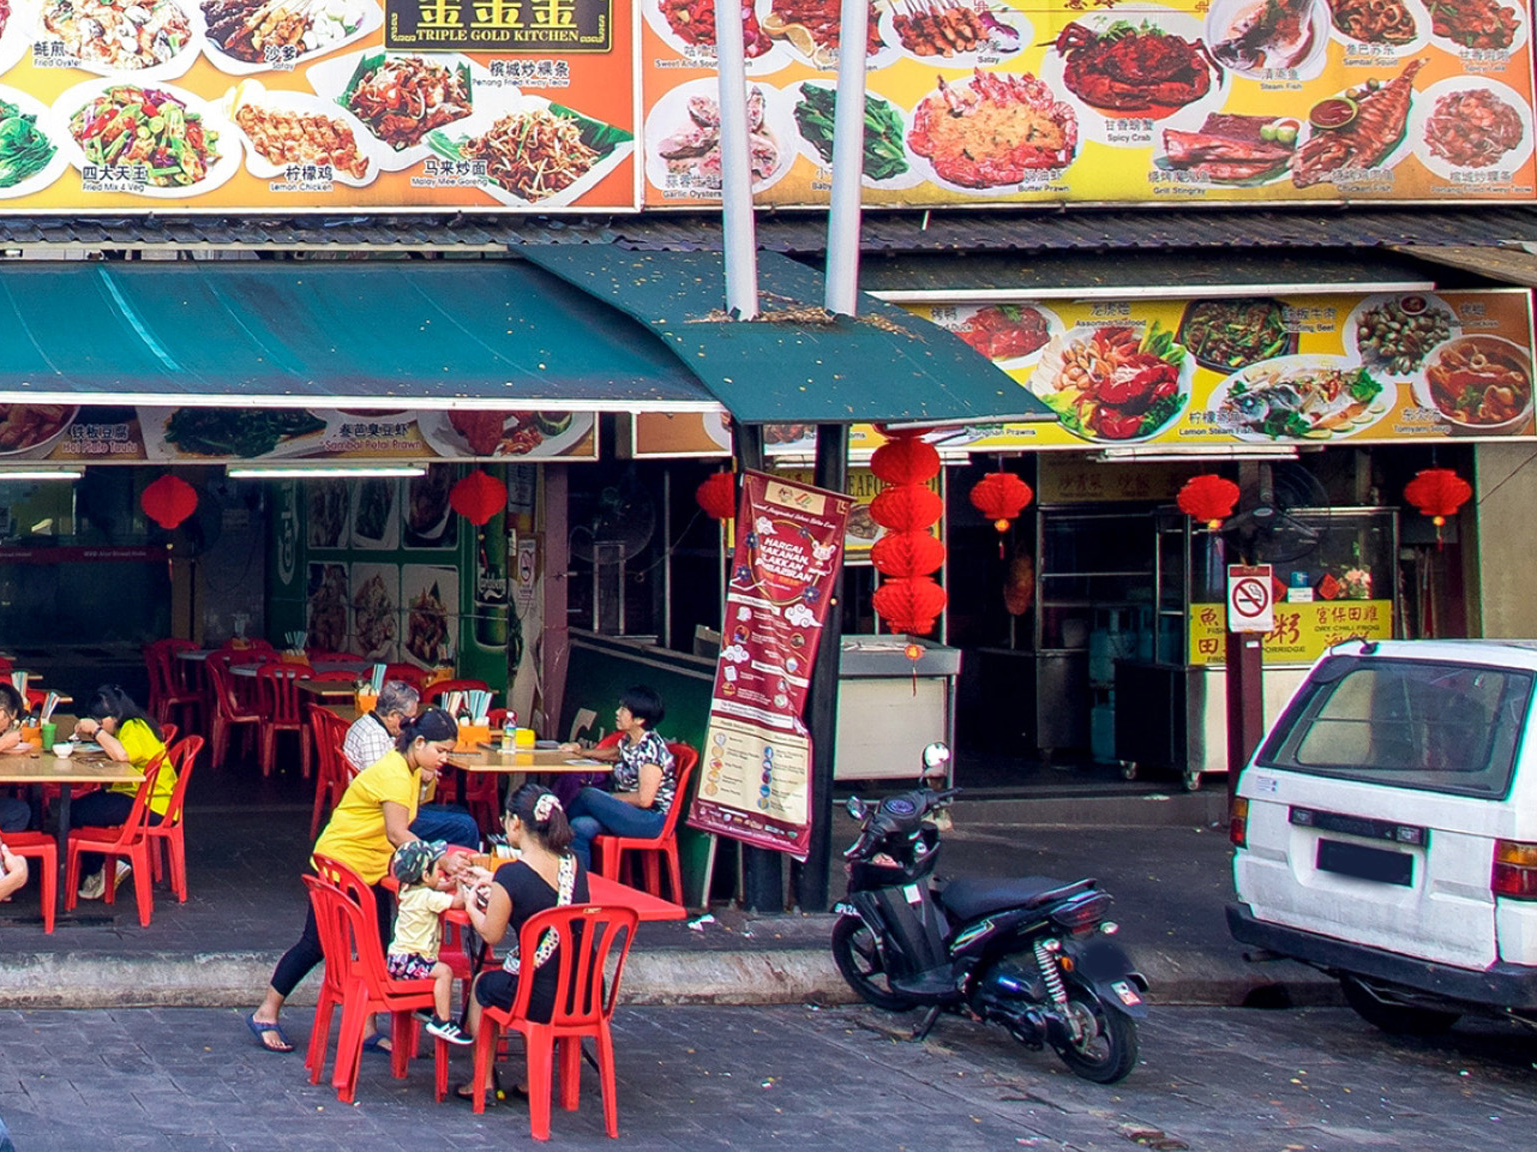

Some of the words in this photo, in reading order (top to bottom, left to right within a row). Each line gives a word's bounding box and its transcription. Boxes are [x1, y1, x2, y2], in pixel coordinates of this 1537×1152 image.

[416, 29, 468, 42] TRIPLE
[470, 29, 511, 42] GOLD
[514, 29, 580, 42] KITCHEN
[34, 58, 54, 67] Fried
[56, 58, 82, 68] Oyster
[656, 59, 680, 67] Sweet
[682, 59, 695, 67] And
[978, 56, 1000, 64] Satay
[472, 78, 502, 88] Penang
[503, 78, 524, 87] Fried
[1107, 134, 1129, 142] Spicy
[285, 165, 334, 181] 柠檬鸡
[424, 161, 487, 176] 马来炒面
[82, 166, 147, 181] 四大天王
[411, 177, 437, 187] Malay
[438, 177, 456, 186] Mee
[458, 177, 488, 187] Goreng
[812, 182, 832, 191] Baby
[82, 182, 103, 192] Fried
[128, 182, 145, 193] Veg
[270, 182, 297, 192] Lemon
[299, 182, 333, 192] Chicken
[1018, 185, 1042, 193] Butter
[1044, 185, 1069, 193] Prawn
[1173, 187, 1206, 195] Stingray
[662, 190, 686, 198] Garlic
[689, 190, 722, 199] Oysters
[952, 323, 973, 331] Duck
[1075, 320, 1111, 328] Assorted
[1113, 319, 1146, 327] Seafood
[1317, 324, 1334, 332] Beef
[1006, 428, 1036, 436] Prawns
[1179, 428, 1206, 436] Lemon
[1430, 425, 1451, 433] Soup
[393, 440, 421, 450] Prawn
